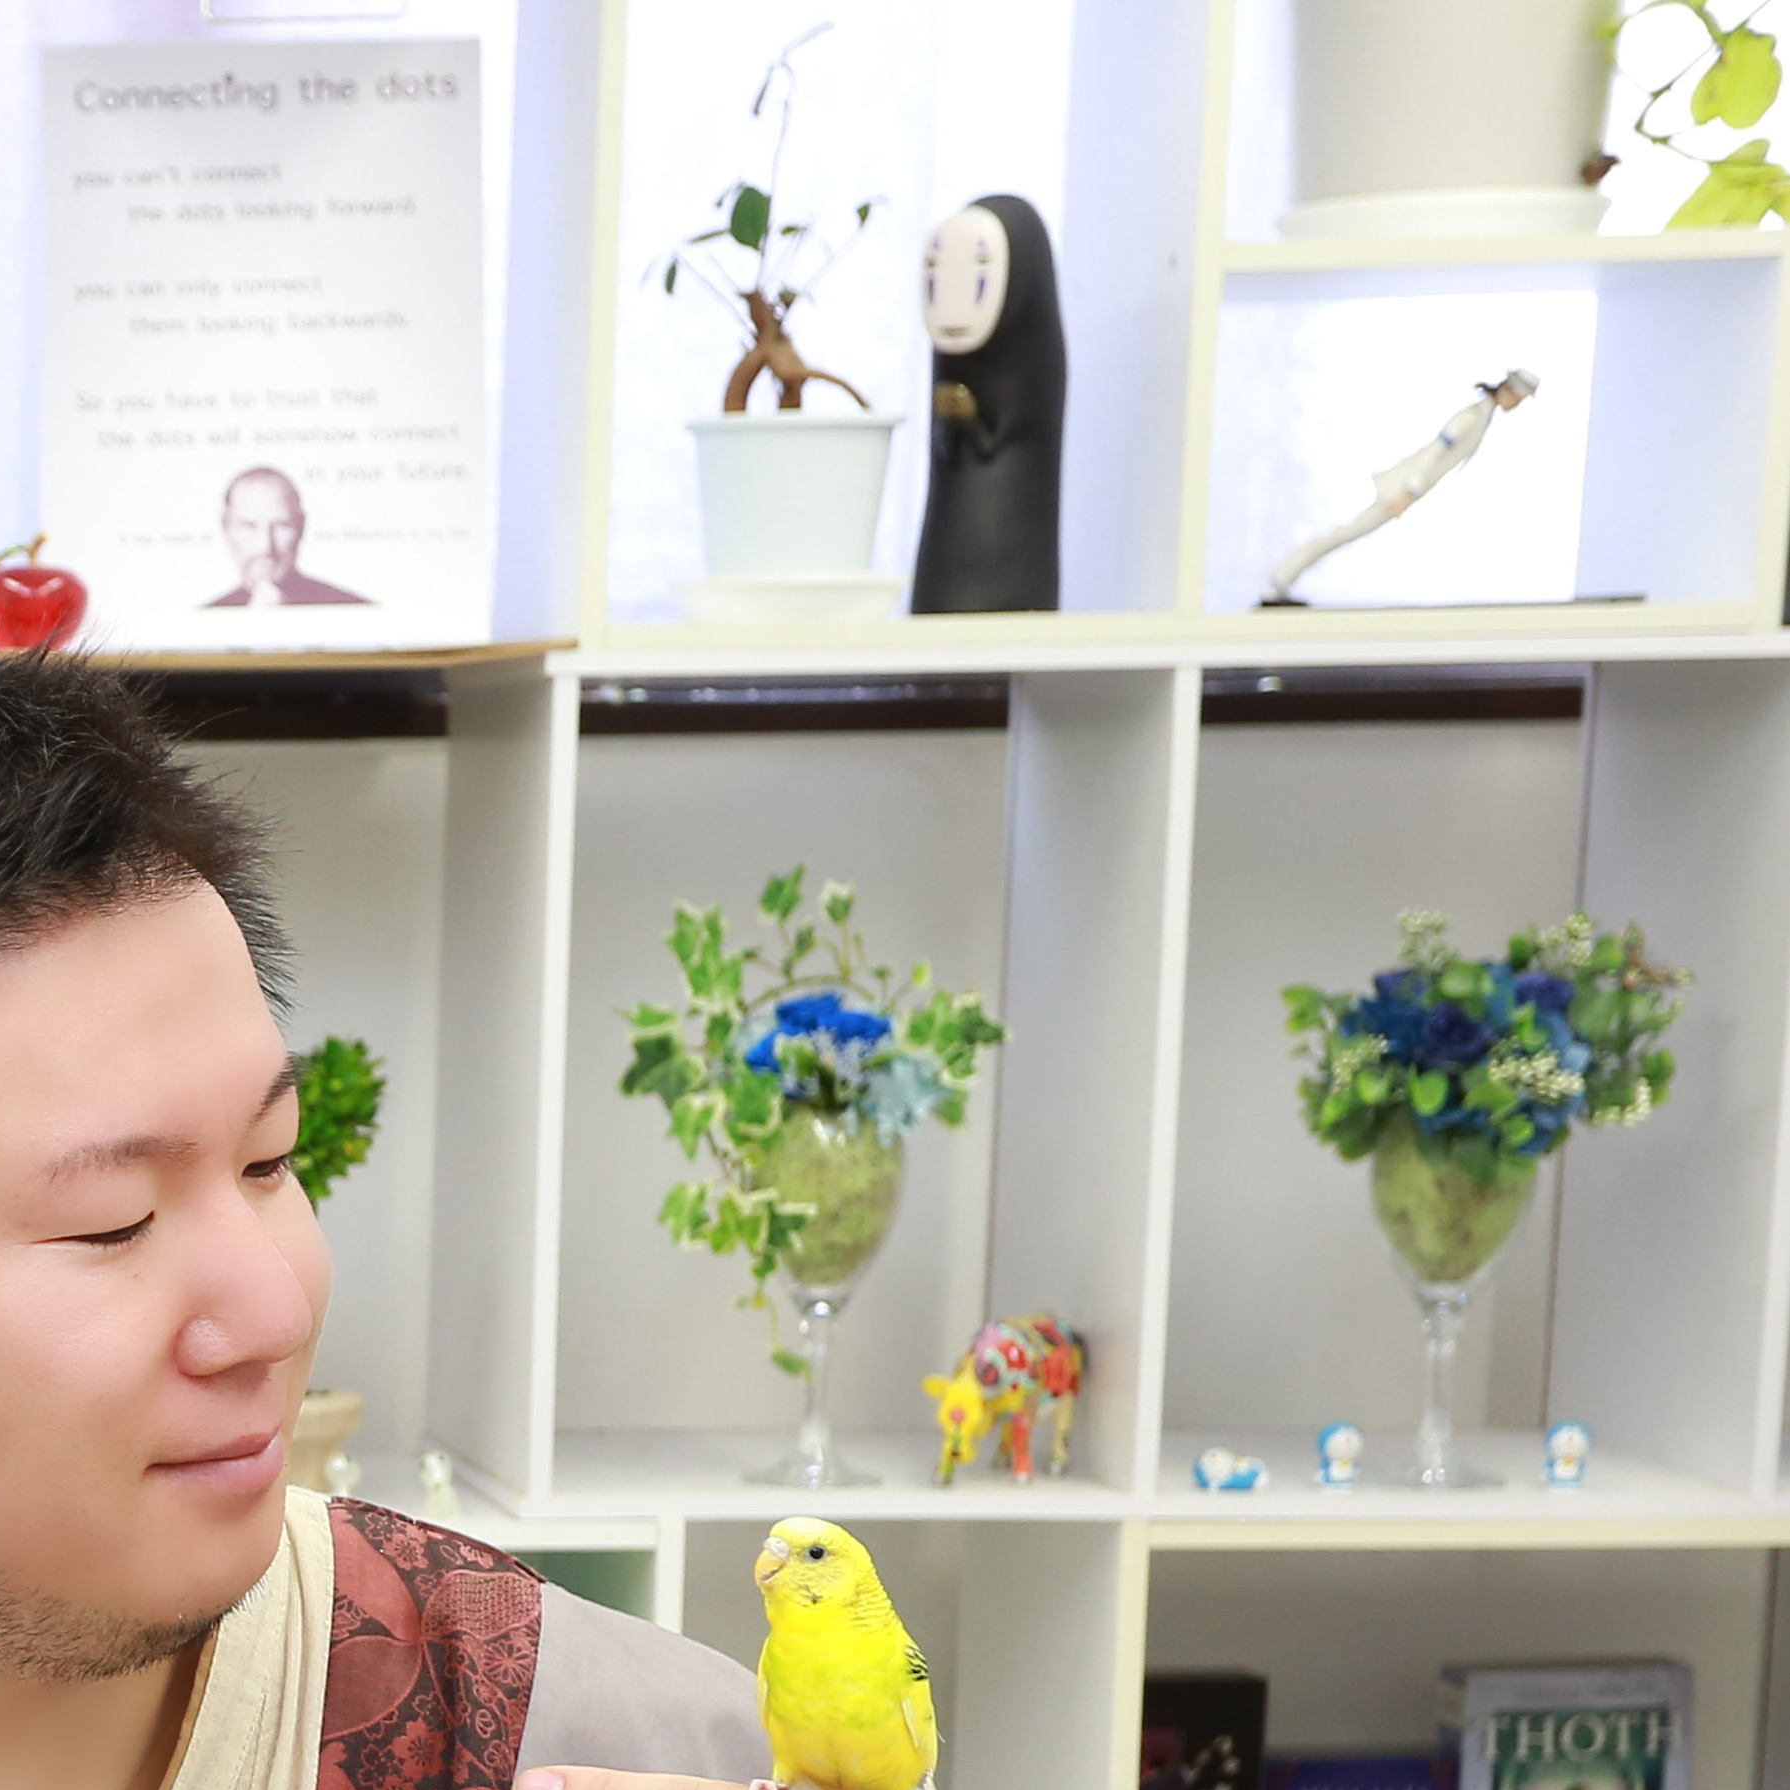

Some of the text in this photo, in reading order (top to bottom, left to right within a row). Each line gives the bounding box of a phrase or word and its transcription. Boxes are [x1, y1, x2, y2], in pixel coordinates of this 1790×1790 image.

[73, 68, 461, 112] Connecting the dots
[72, 162, 282, 191] you can't connect
[126, 203, 163, 222] the
[175, 202, 227, 221] dots
[235, 199, 316, 223] looking
[73, 274, 324, 302] you can only connect
[127, 315, 187, 335] them
[196, 313, 277, 336] looking
[75, 386, 379, 415] So you have to trust that
[97, 422, 461, 449] the dots will somehow connect
[305, 464, 327, 482] in
[335, 464, 385, 486] your
[1474, 1709, 1682, 1761] THOTH
